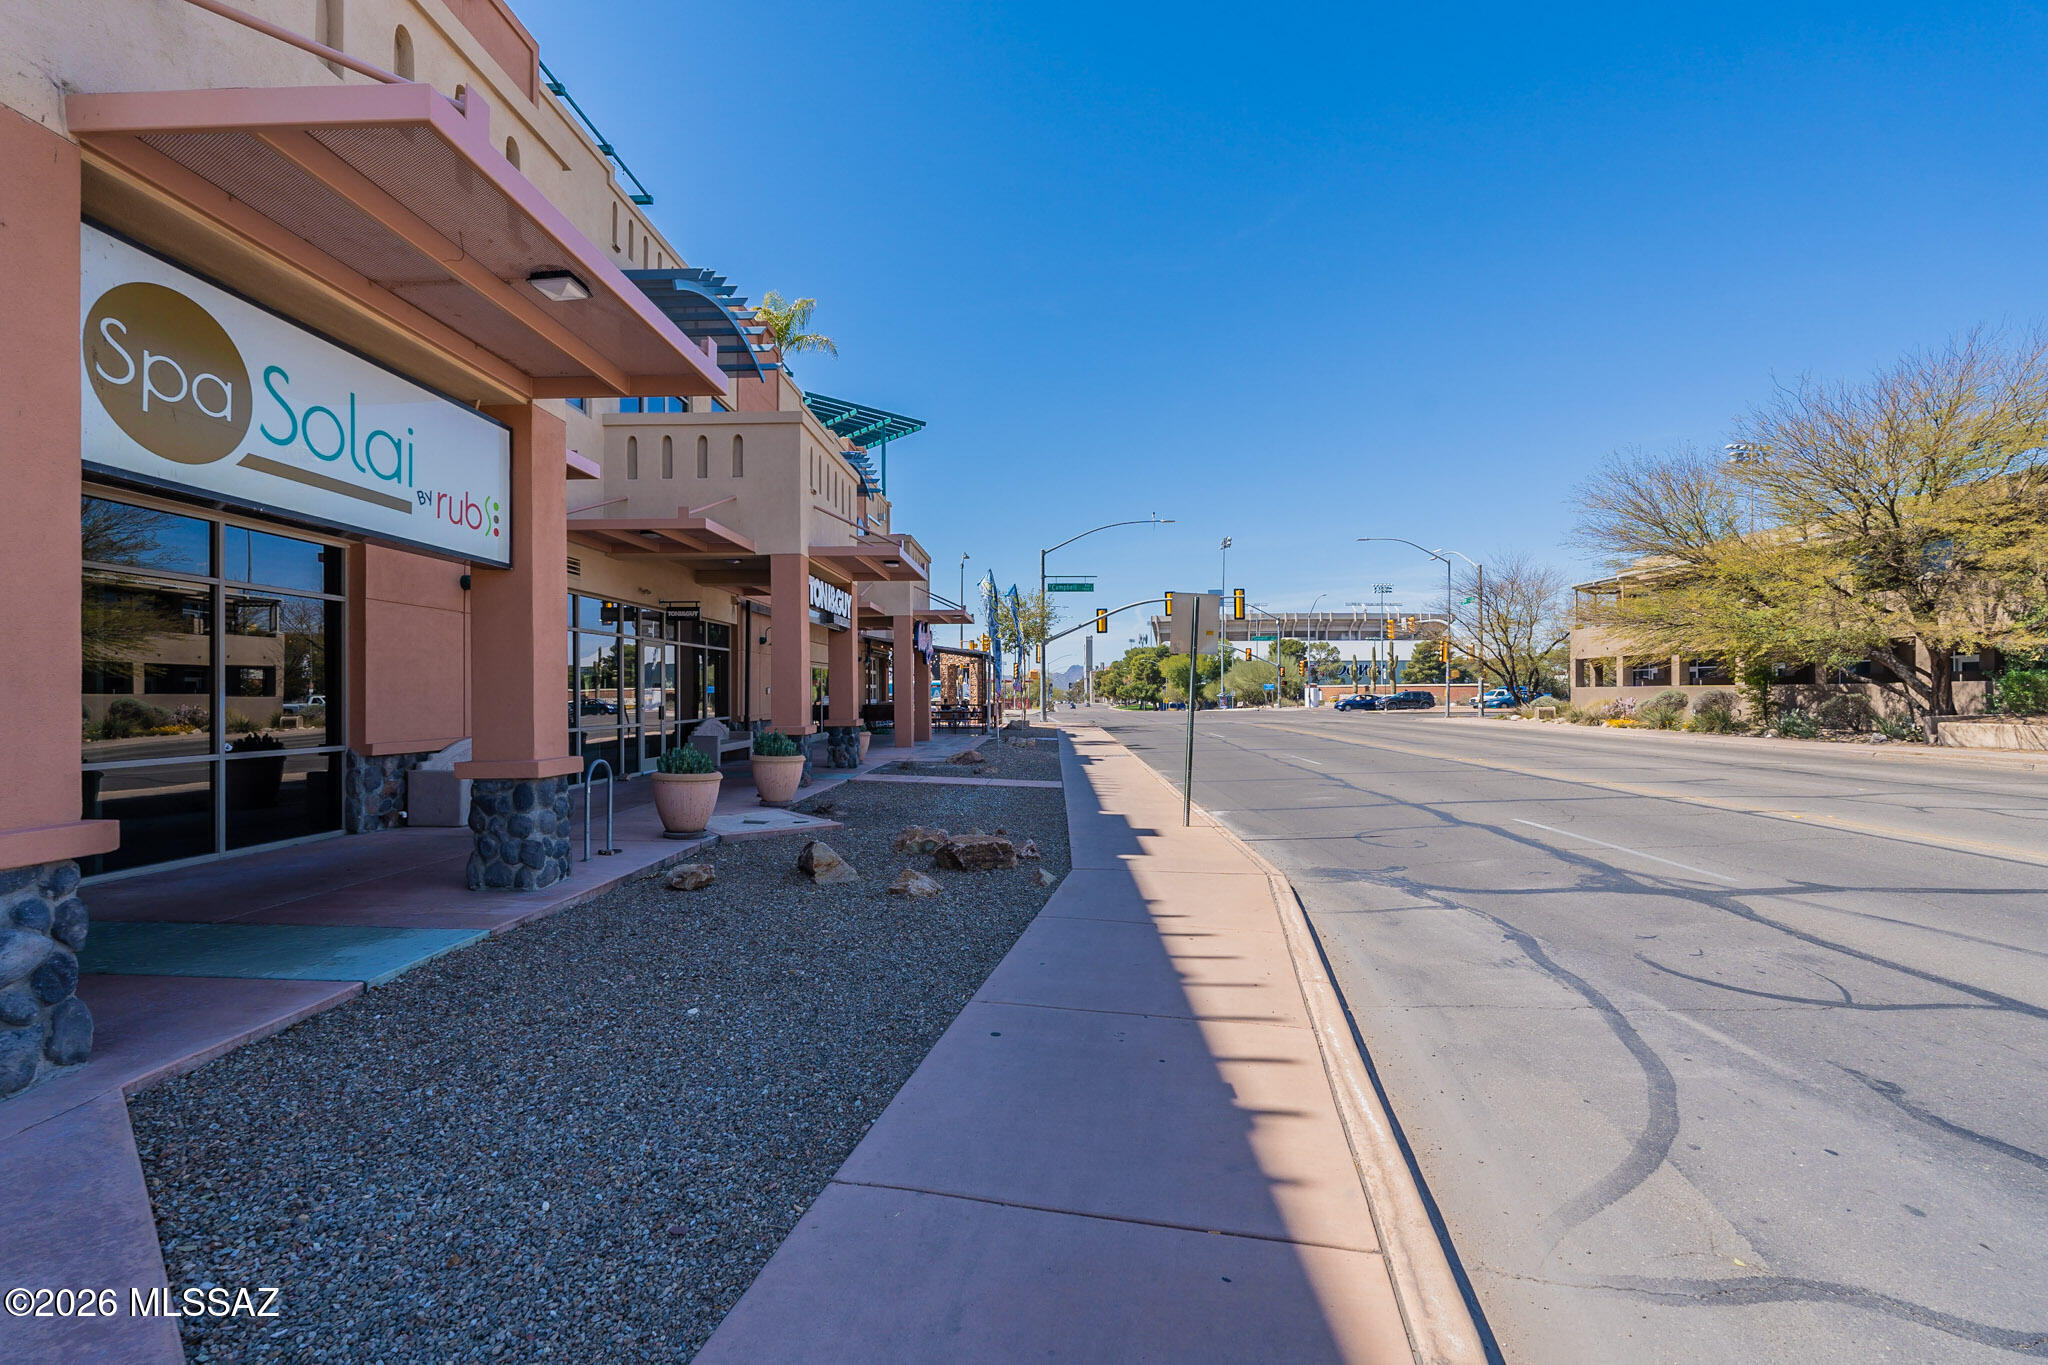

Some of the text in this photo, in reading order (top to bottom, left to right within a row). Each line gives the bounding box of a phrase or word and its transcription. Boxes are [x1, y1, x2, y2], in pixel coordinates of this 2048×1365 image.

[95, 317, 413, 488] Spa Solai
[416, 490, 432, 506] BY
[809, 575, 852, 619] TONI&GUY
